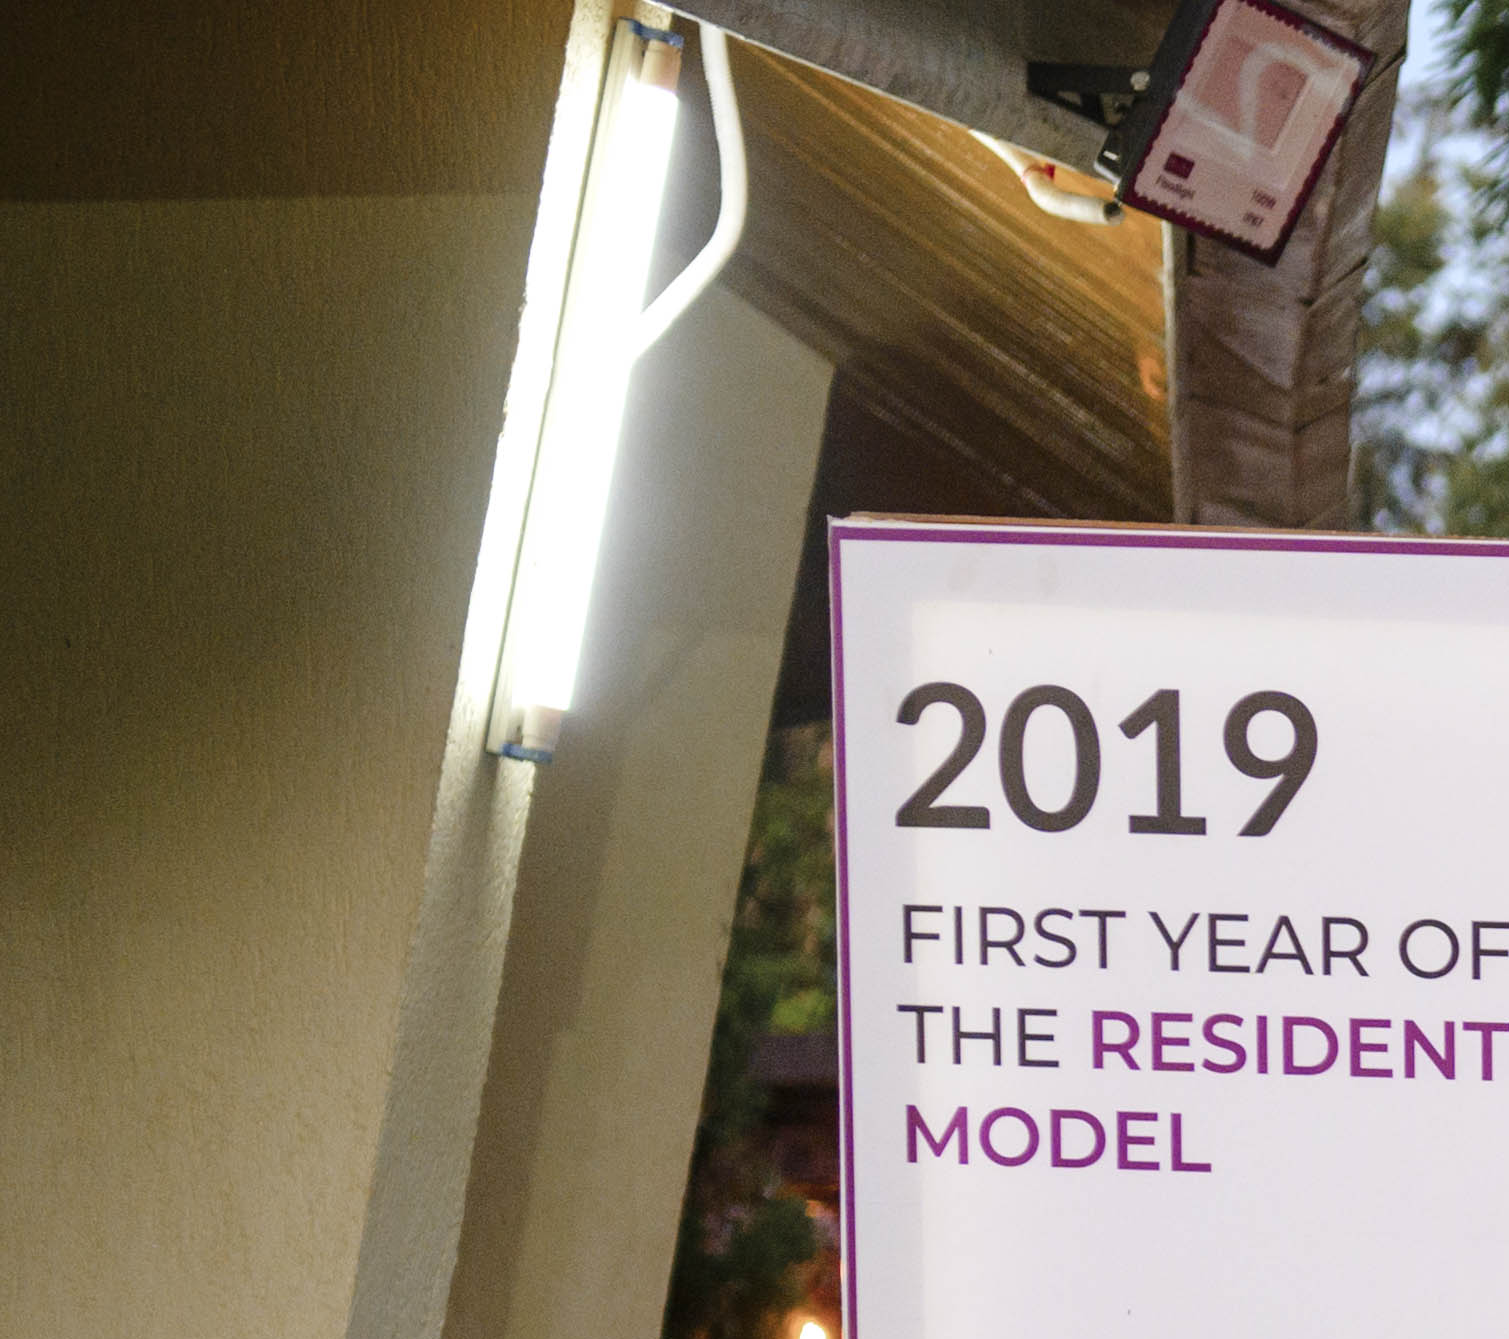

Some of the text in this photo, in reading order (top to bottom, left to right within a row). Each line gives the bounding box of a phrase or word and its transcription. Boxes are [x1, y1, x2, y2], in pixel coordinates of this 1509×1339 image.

[895, 681, 1318, 838] 2019
[901, 904, 1125, 970] FIRST
[1149, 912, 1369, 976] YEAR
[897, 1004, 1061, 1068] THE
[906, 1105, 1212, 1172] MODEL
